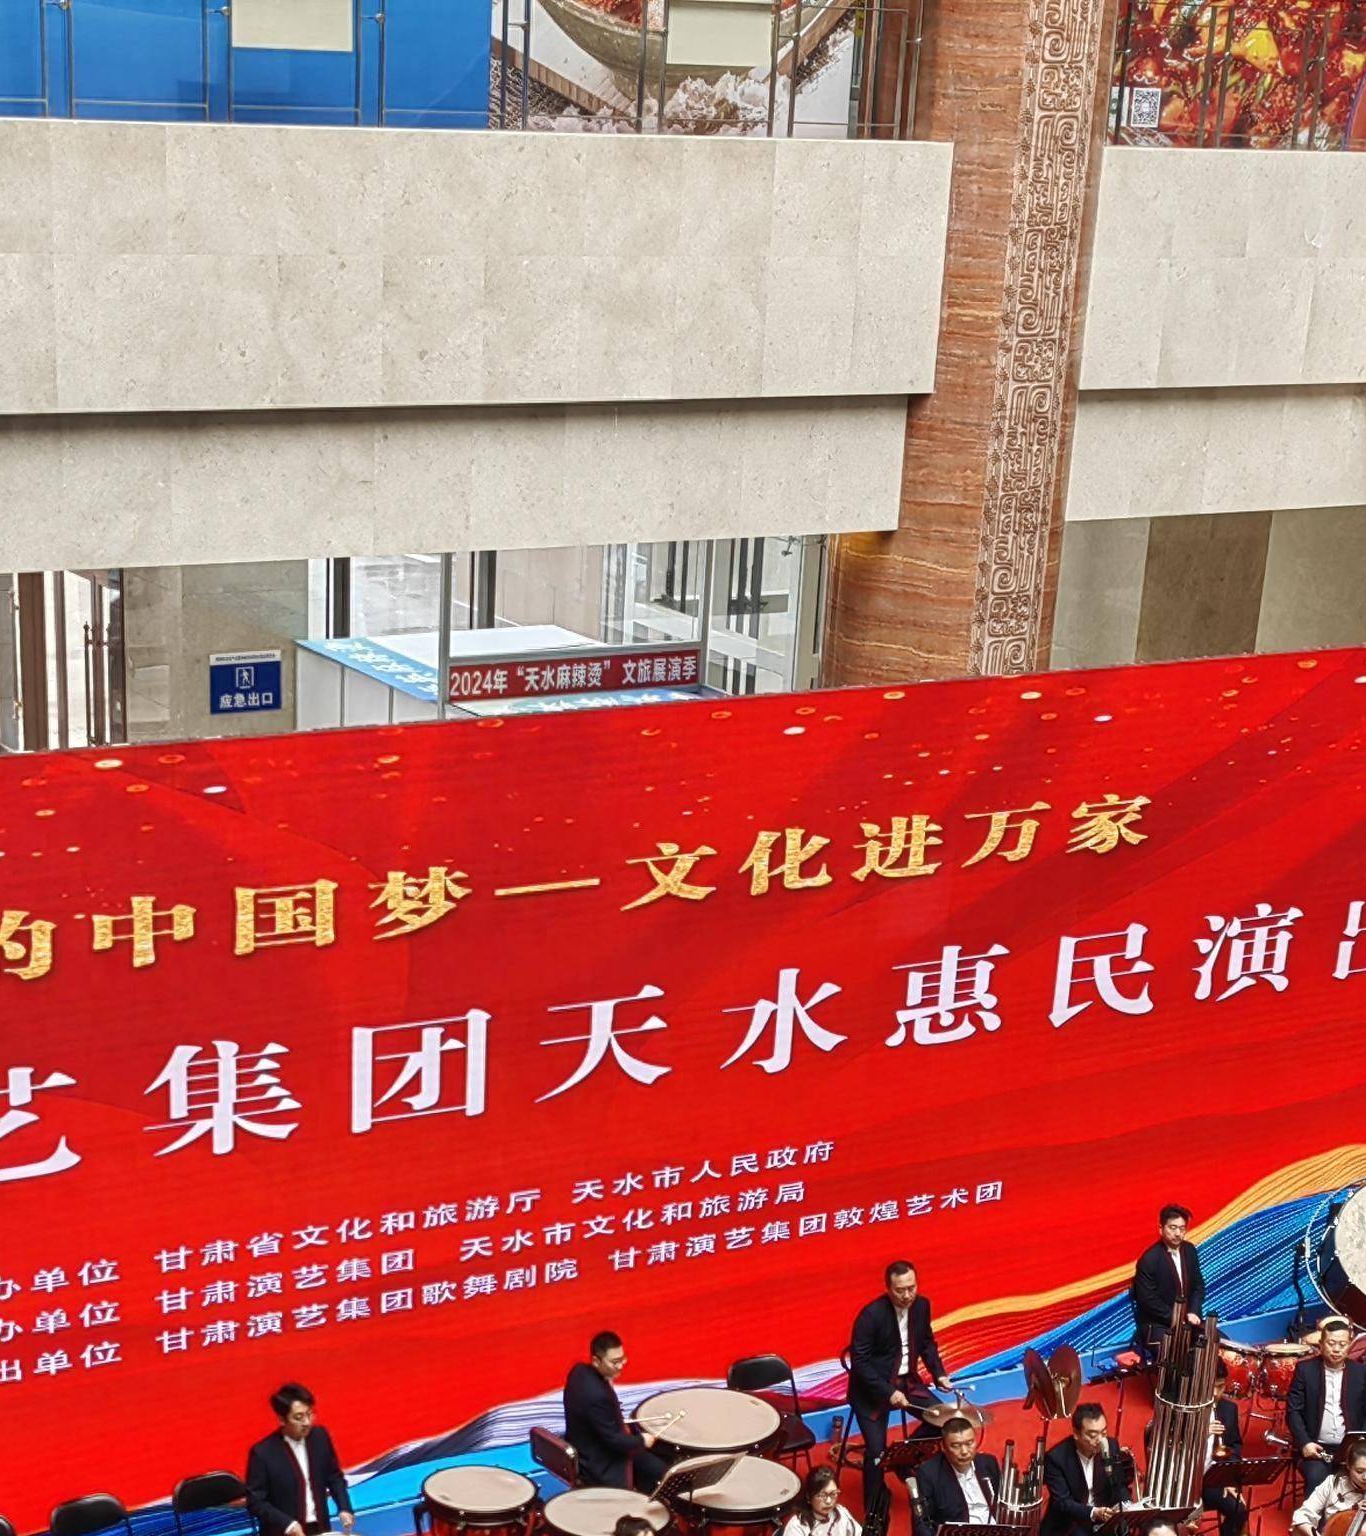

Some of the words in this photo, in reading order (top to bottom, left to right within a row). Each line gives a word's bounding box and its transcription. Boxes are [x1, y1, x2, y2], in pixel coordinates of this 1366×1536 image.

[219, 692, 273, 709] 应急出口
[154, 1189, 541, 1273] 甘肃省文化和旅游厅
[571, 1140, 835, 1204] 天水市人民政府
[154, 1248, 414, 1313] 甘肃演艺集团
[459, 1181, 805, 1262] 天水市文化和旅游局
[155, 1257, 578, 1354] 甘肃演艺集团歌舞剧院
[608, 1180, 1004, 1272] 甘肃演艺集团敦煌艺术团
